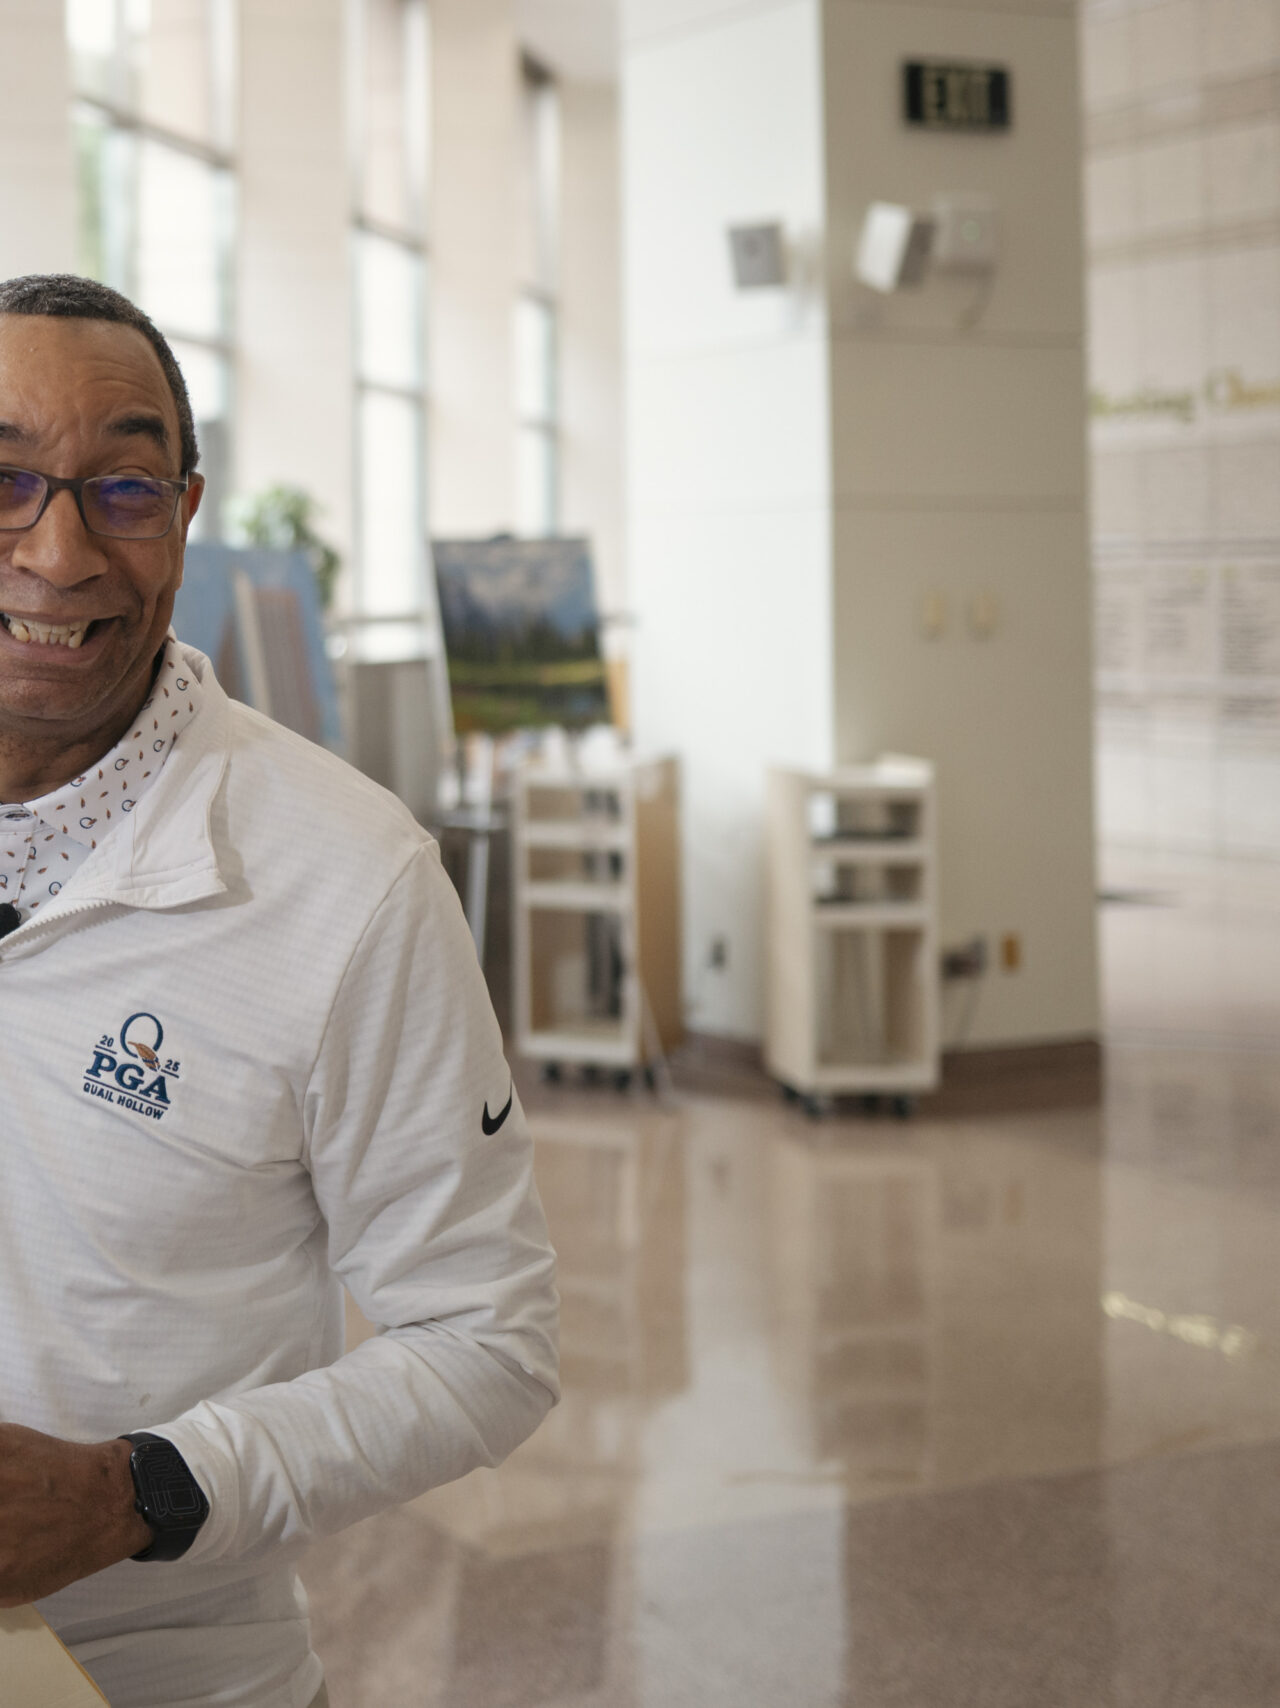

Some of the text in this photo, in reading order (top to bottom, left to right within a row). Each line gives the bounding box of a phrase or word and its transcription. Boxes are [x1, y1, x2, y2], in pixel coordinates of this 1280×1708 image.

[100, 1034, 115, 1048] 20
[86, 1050, 171, 1105] PGA
[165, 1059, 181, 1073] 25
[83, 1082, 165, 1120] QUAIL HOLLOW
